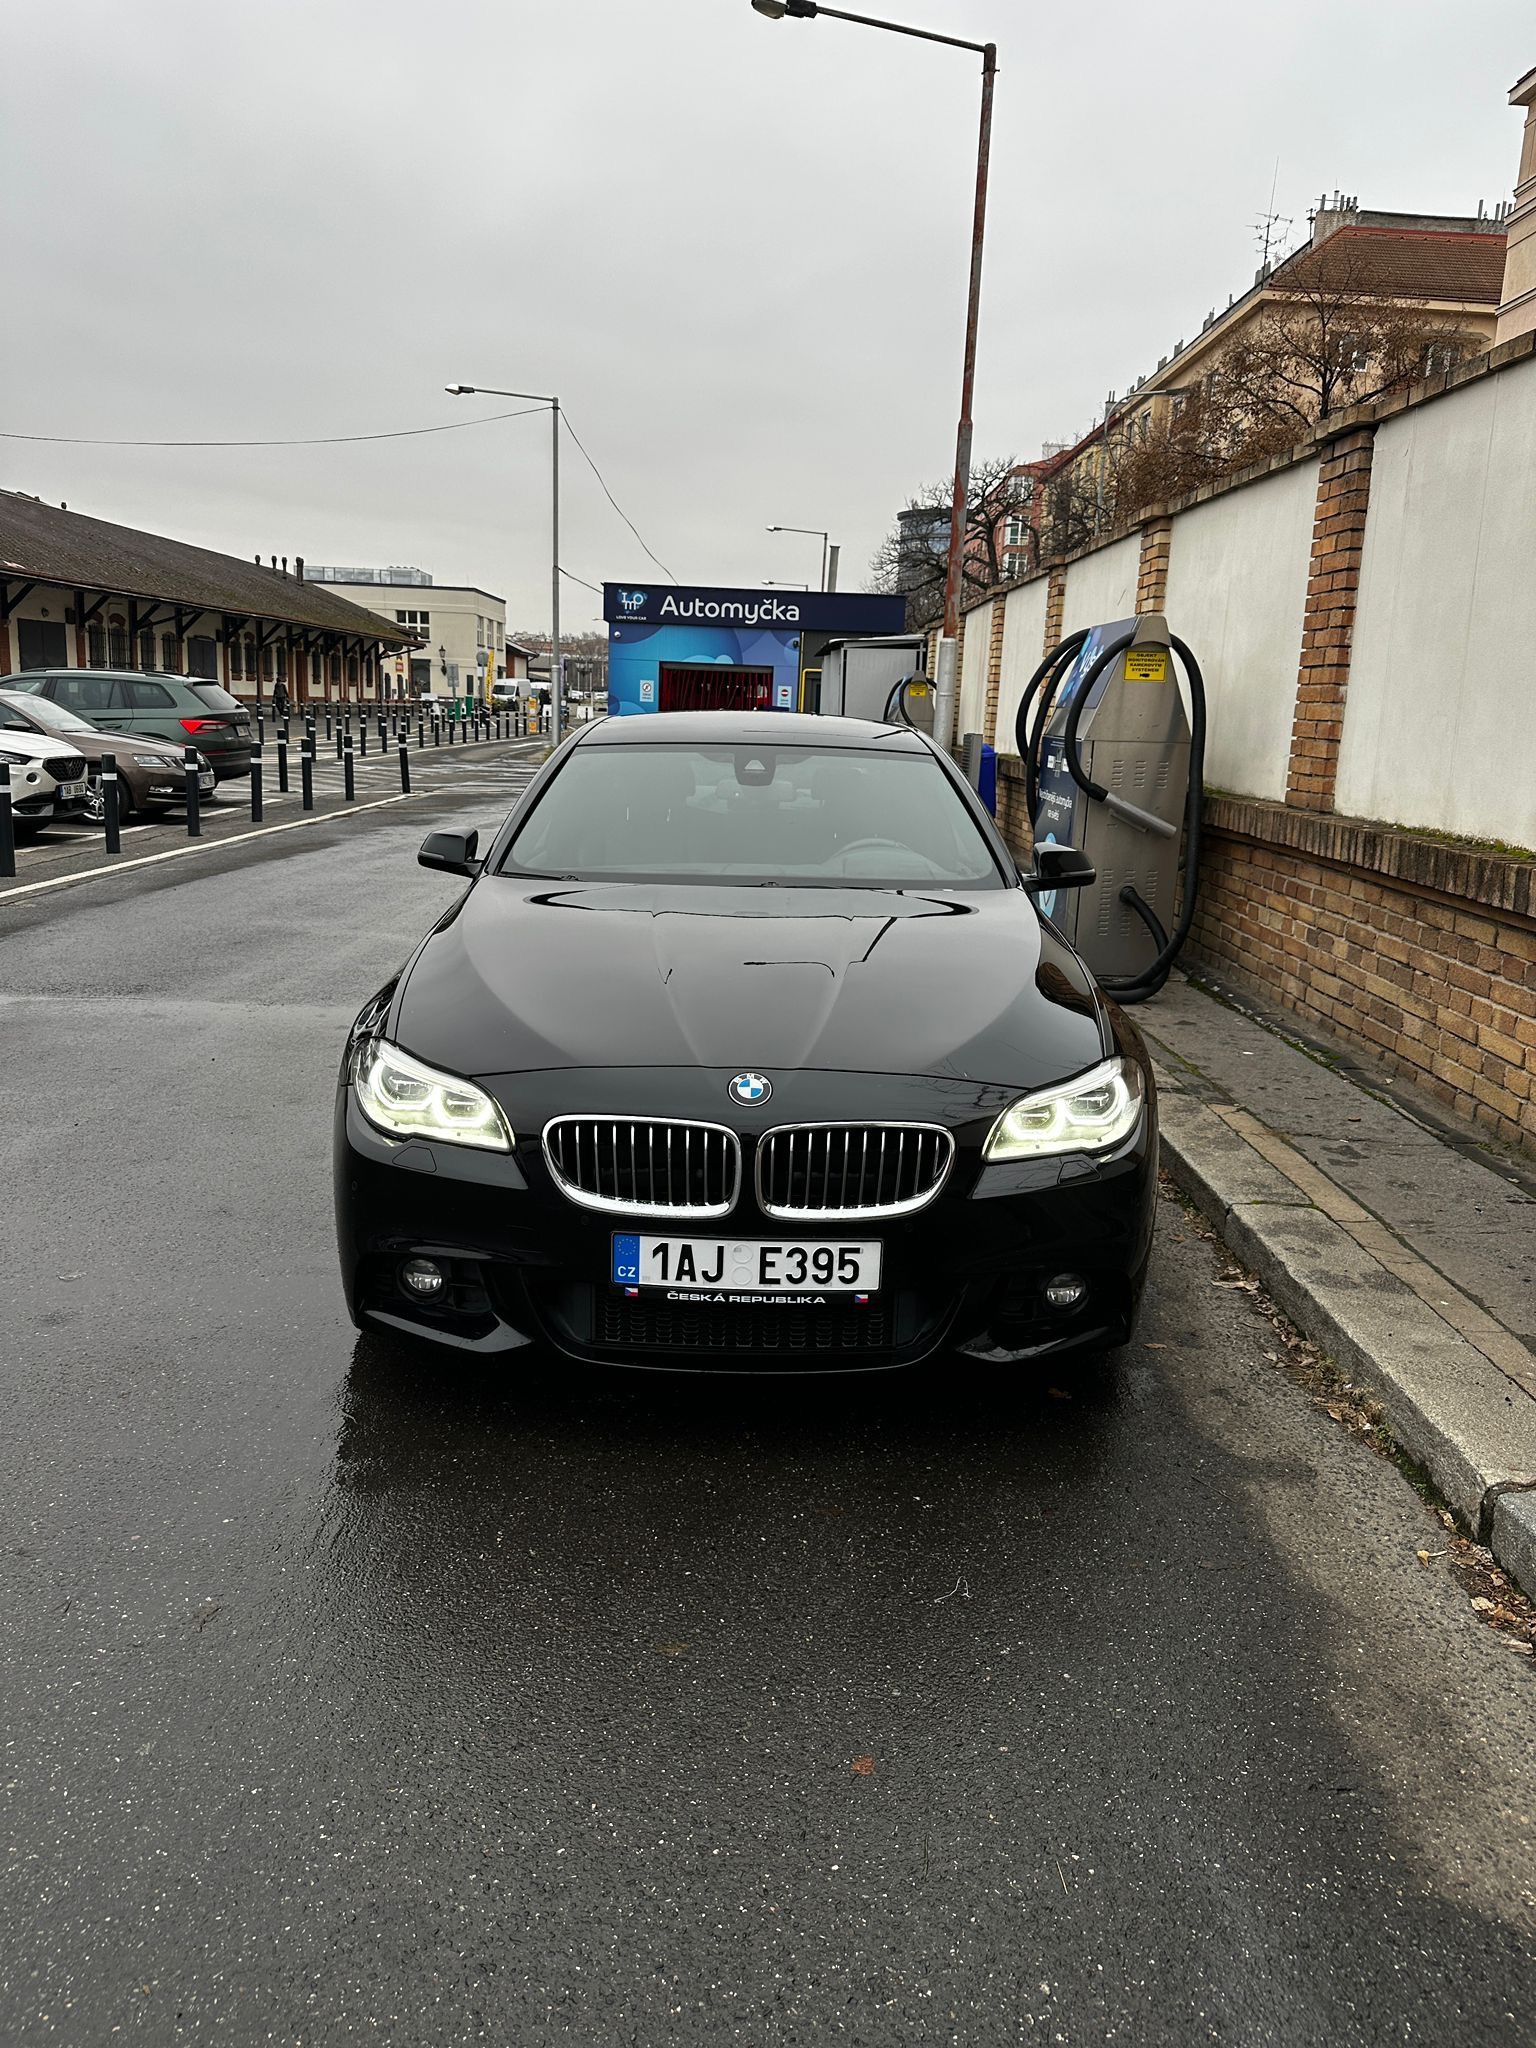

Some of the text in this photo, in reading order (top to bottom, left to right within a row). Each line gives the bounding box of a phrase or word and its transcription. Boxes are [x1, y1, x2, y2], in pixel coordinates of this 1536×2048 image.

[659, 595, 800, 624] Automyčka
[732, 1073, 769, 1084] BMW
[652, 1243, 862, 1285] 1AJ E395
[617, 1265, 636, 1278] CZ
[666, 1291, 826, 1305] ČESKÁ REPUBLIKA
